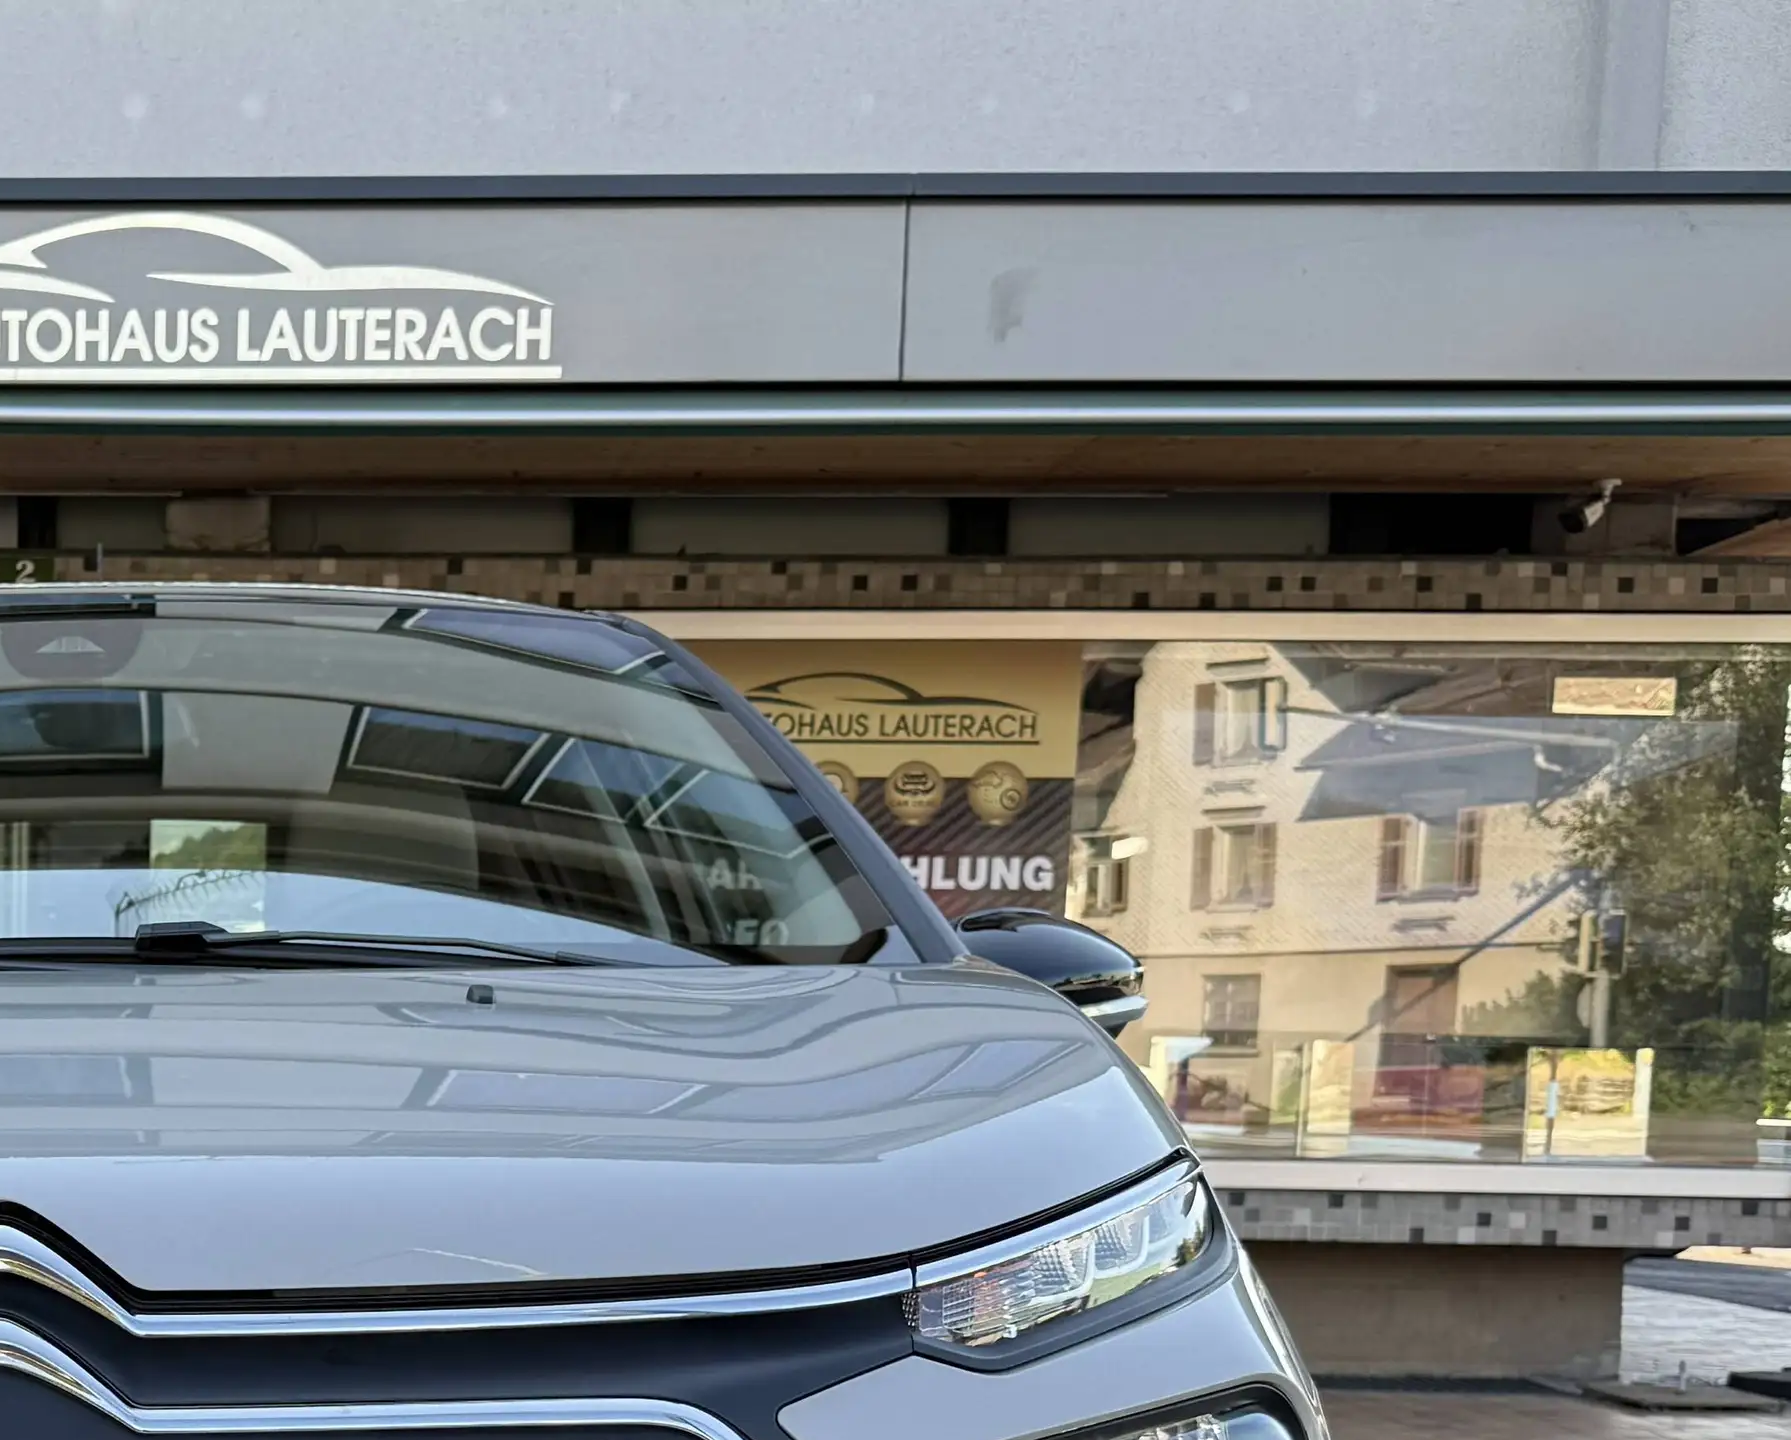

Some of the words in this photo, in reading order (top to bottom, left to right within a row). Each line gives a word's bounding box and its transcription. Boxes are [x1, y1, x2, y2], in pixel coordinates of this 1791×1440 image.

[237, 306, 552, 362] LAUTERACH
[15, 560, 35, 583] 2
[763, 712, 869, 737] OHAUS
[879, 714, 1037, 738] LAUTERACH
